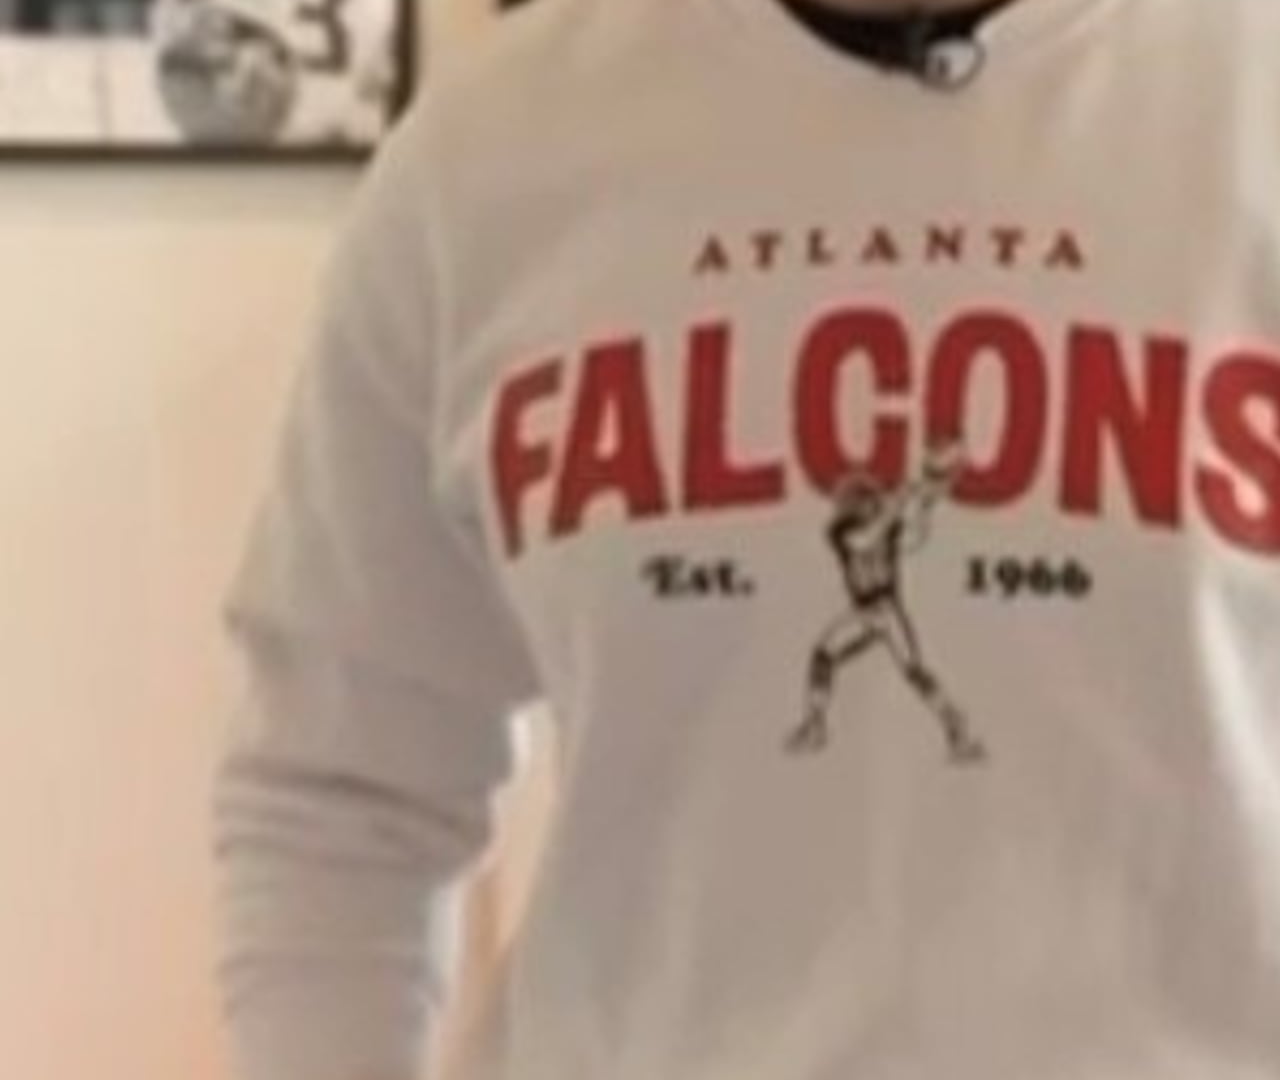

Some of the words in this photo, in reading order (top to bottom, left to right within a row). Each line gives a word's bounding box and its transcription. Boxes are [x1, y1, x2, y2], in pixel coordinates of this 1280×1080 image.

[692, 225, 1086, 272] ATLANTA
[644, 556, 754, 598] Est.
[965, 556, 1091, 598] 1966
